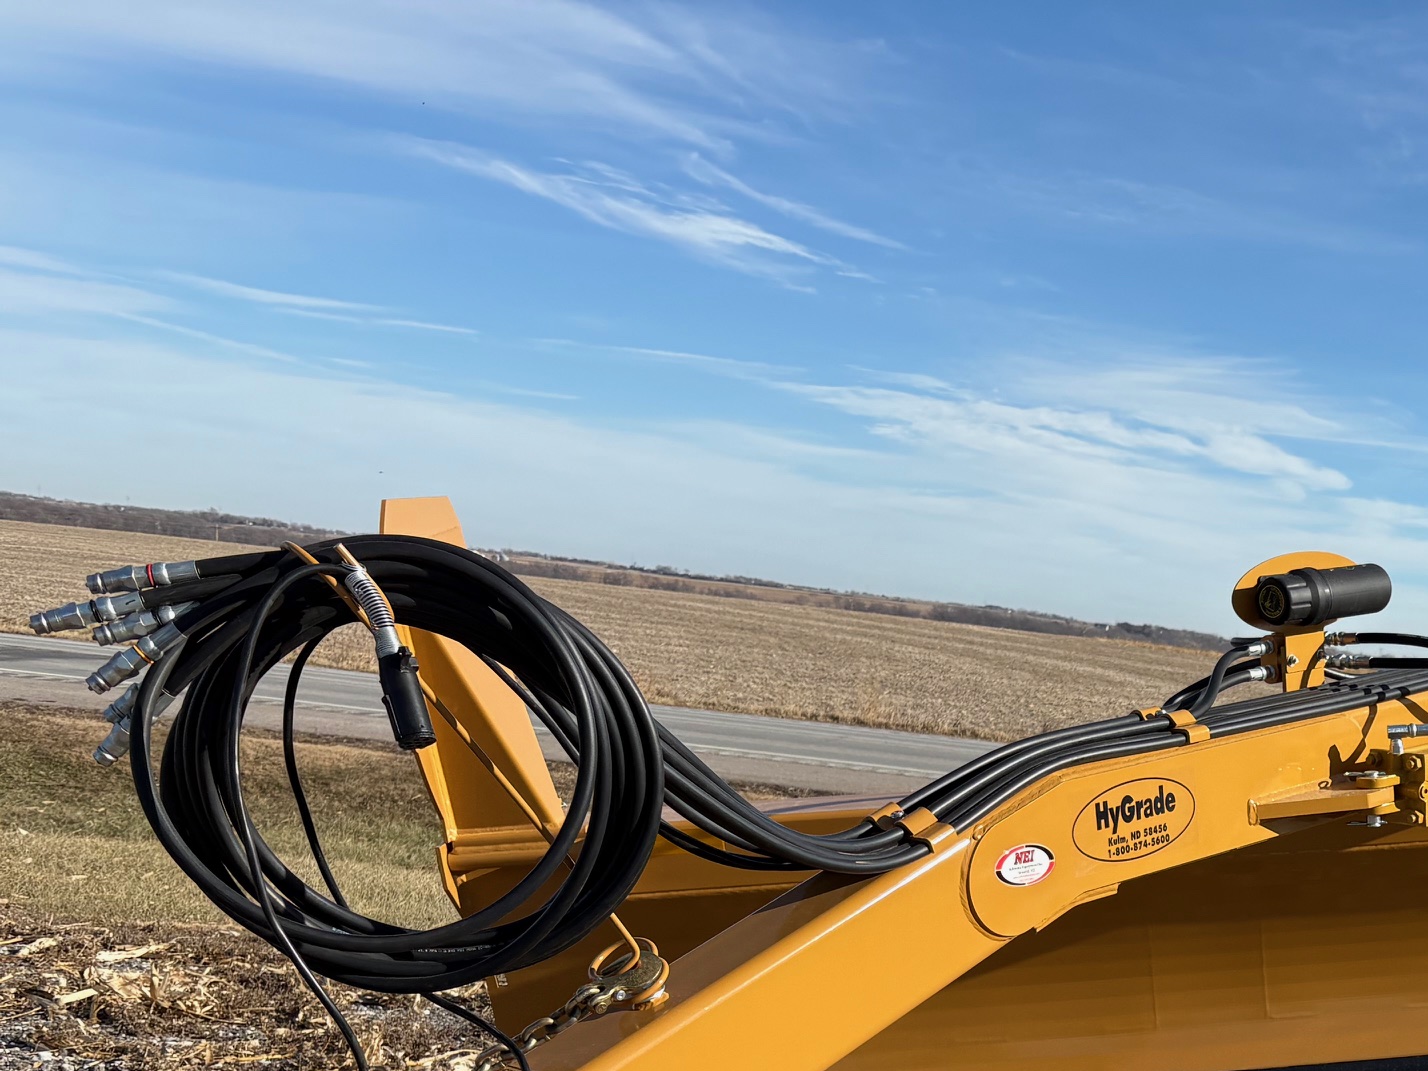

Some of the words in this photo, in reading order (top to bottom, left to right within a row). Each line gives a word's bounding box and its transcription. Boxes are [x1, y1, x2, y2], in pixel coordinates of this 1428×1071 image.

[1095, 785, 1176, 835] HyGrade
[1108, 835, 1129, 847] Kulm,
[1130, 830, 1141, 841] ND
[1144, 823, 1168, 837] 58456
[1108, 834, 1170, 858] 1-800-874-5600
[1014, 850, 1035, 865] NEI
